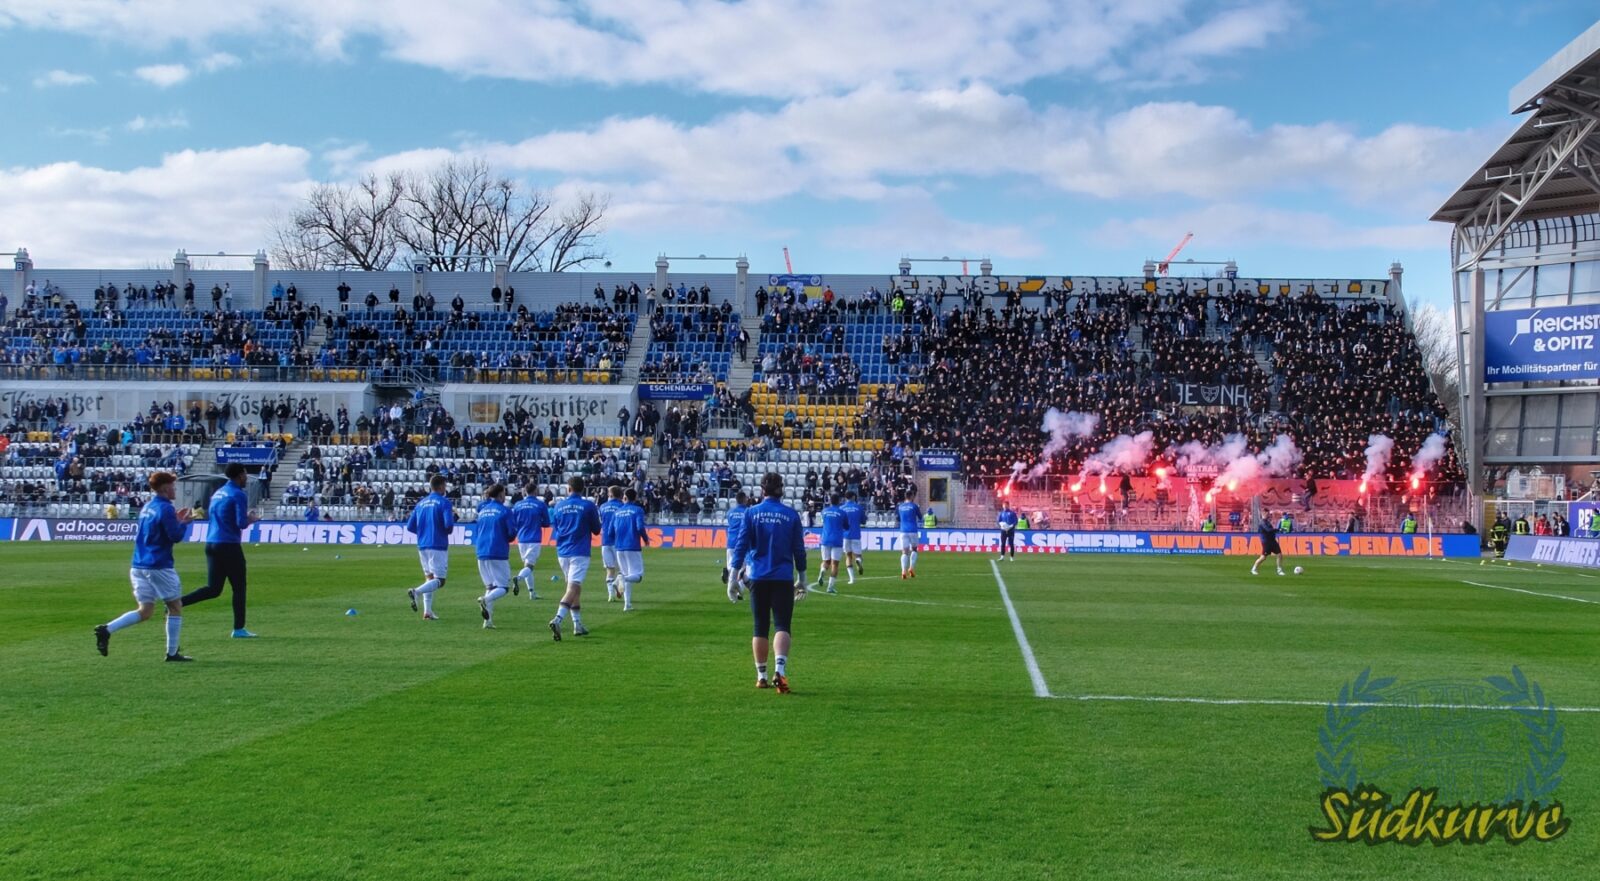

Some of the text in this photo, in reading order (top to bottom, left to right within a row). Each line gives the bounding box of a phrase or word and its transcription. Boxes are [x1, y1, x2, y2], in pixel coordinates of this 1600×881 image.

[1533, 334, 1594, 352] & OPITZ
[1487, 361, 1598, 375] Ihr Mobilitätspartner für
[649, 384, 703, 392] ESCHENBACH
[56, 520, 139, 533] ad hoc aren
[259, 524, 356, 544] TICKETS
[1150, 535, 1444, 557] WWW.BAKETS-JENA.DE
